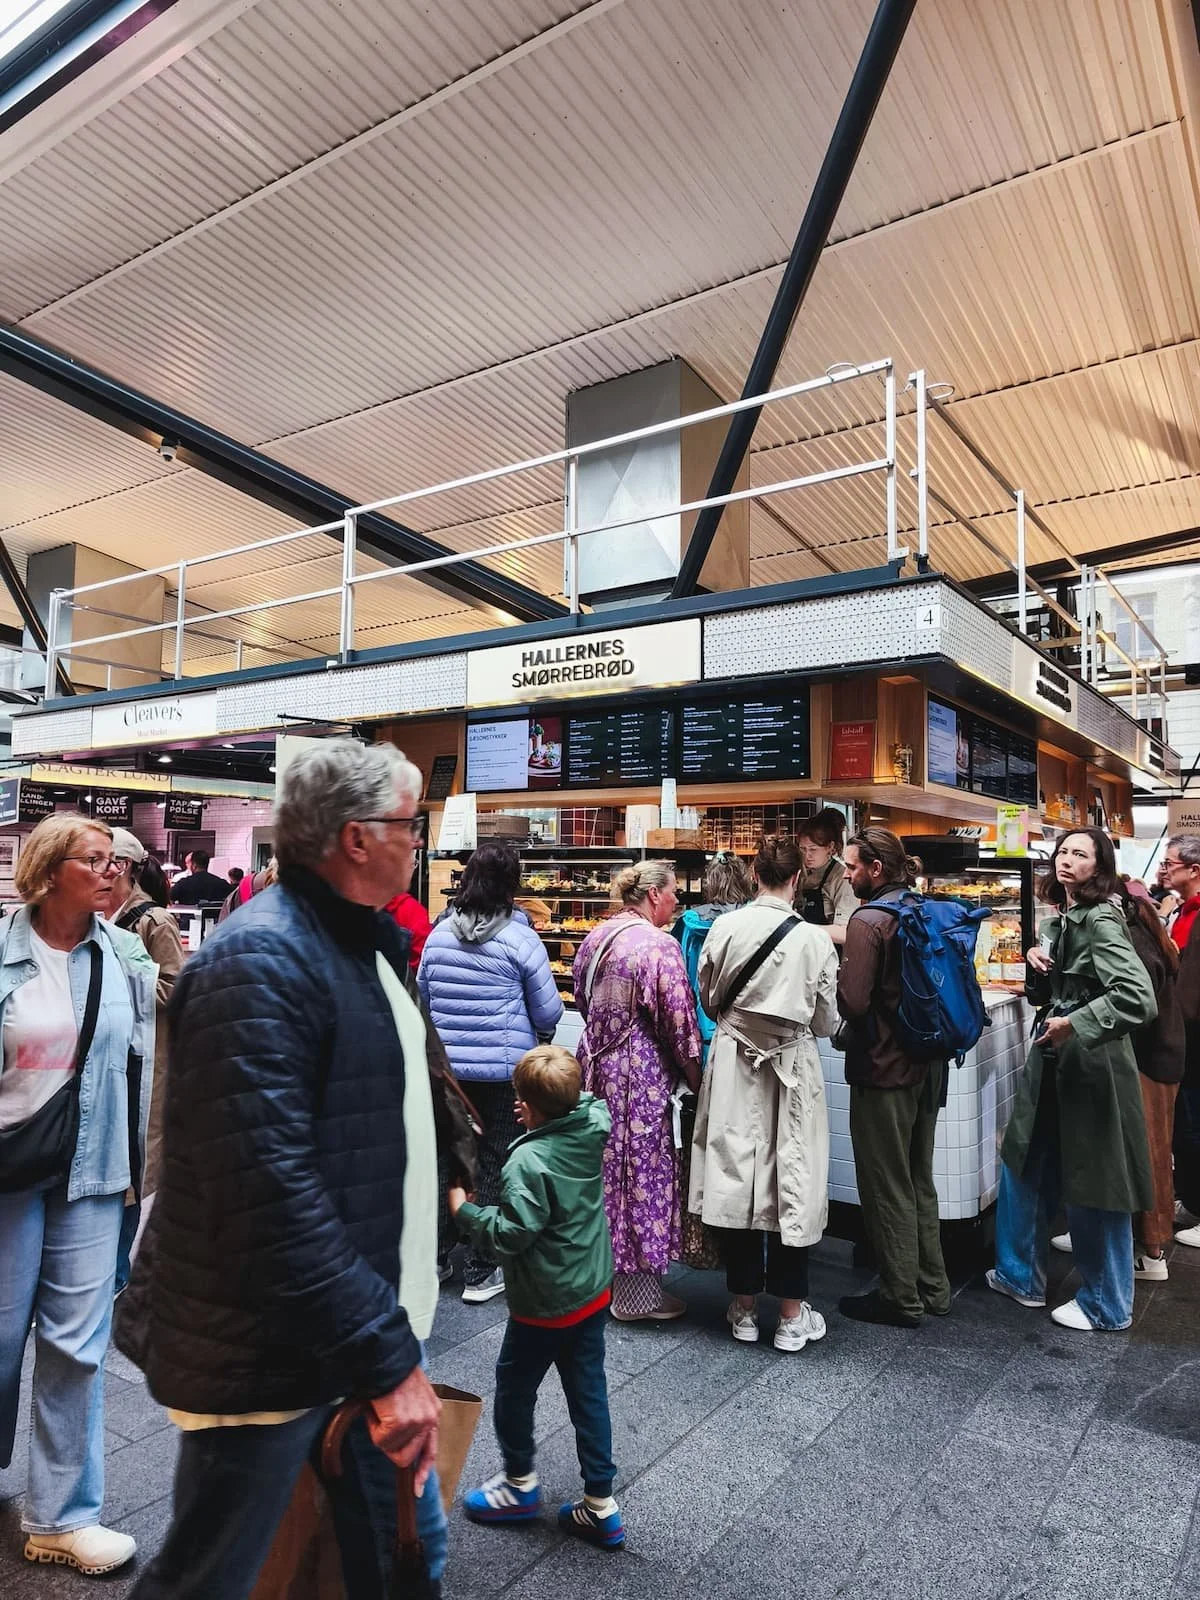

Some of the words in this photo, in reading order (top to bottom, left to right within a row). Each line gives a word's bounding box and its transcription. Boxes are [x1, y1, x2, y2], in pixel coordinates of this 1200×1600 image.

[923, 609, 933, 625] 4
[521, 639, 625, 668] HALLERNES
[511, 659, 635, 688] SMØRREBRØD
[19, 799, 54, 807] LLINGER
[95, 796, 127, 806] GAVE
[95, 805, 128, 815] KORT
